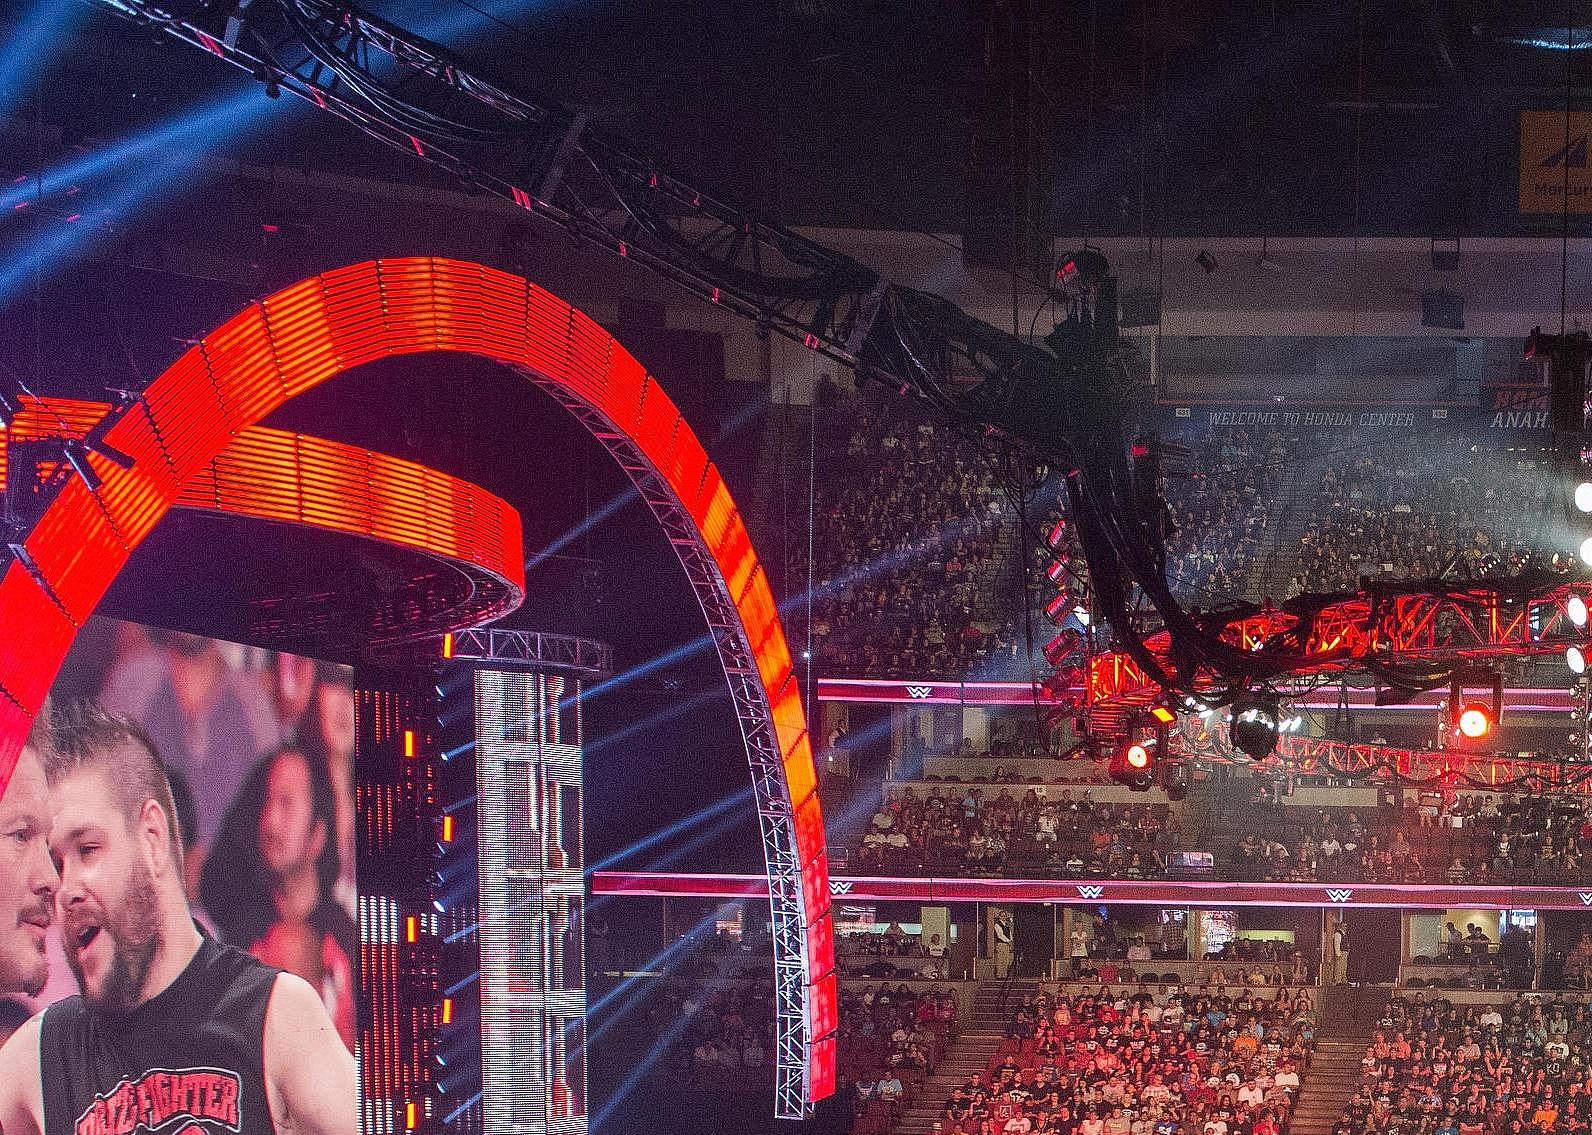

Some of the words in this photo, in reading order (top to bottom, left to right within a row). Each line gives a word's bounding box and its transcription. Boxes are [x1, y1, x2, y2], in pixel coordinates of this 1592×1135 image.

[1208, 411, 1279, 427] WELCOME
[1283, 412, 1300, 426] TO
[1303, 412, 1351, 427] HONDA
[1359, 412, 1415, 427] CENTER
